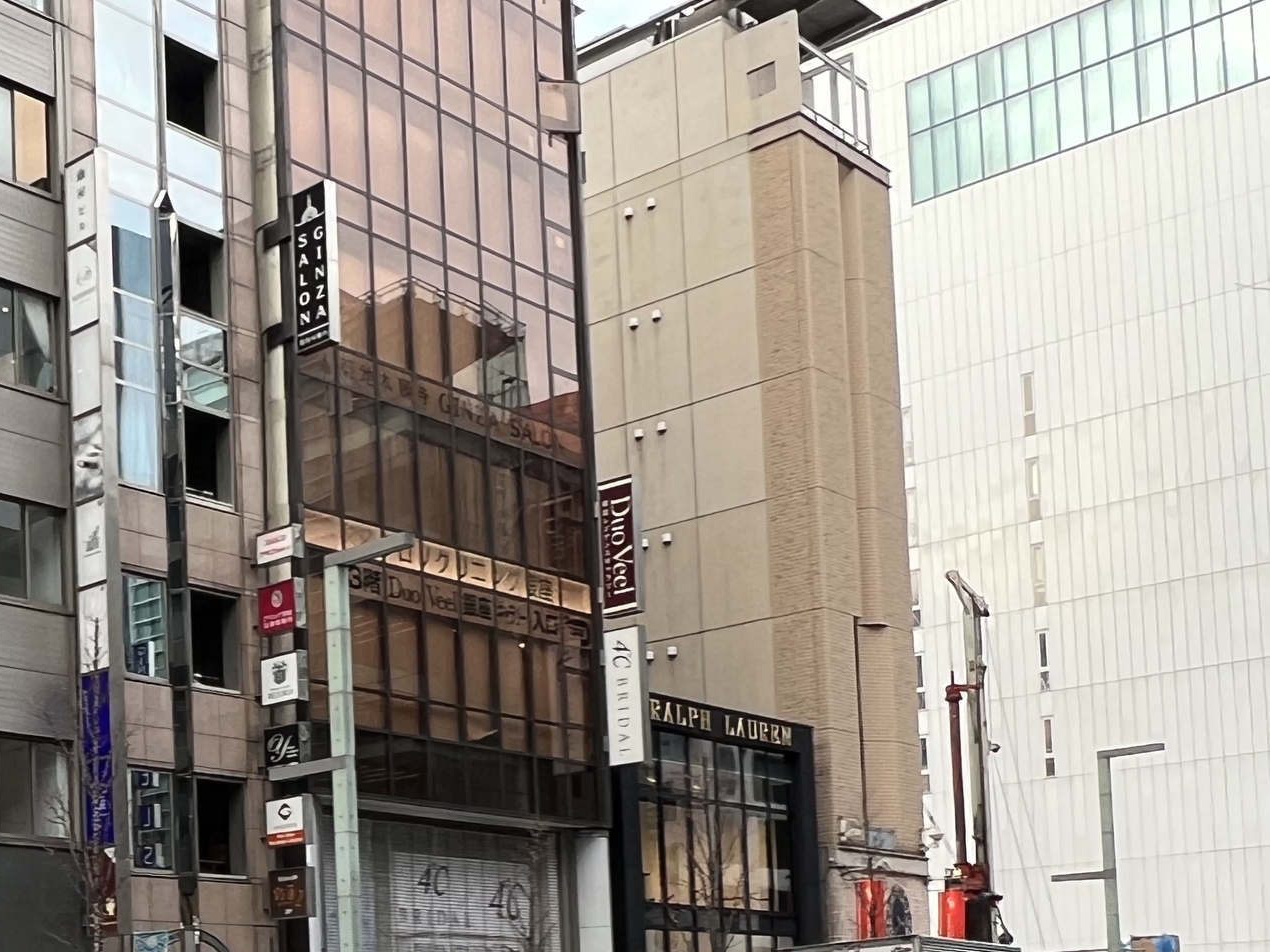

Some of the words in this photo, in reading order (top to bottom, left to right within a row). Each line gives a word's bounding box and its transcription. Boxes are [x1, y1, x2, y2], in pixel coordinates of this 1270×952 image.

[297, 233, 311, 326] SALON
[313, 225, 328, 320] GINZA
[610, 495, 632, 546] Duo
[612, 545, 636, 596] Veel
[648, 698, 713, 732] RALPH
[724, 714, 793, 747] LAUREN
